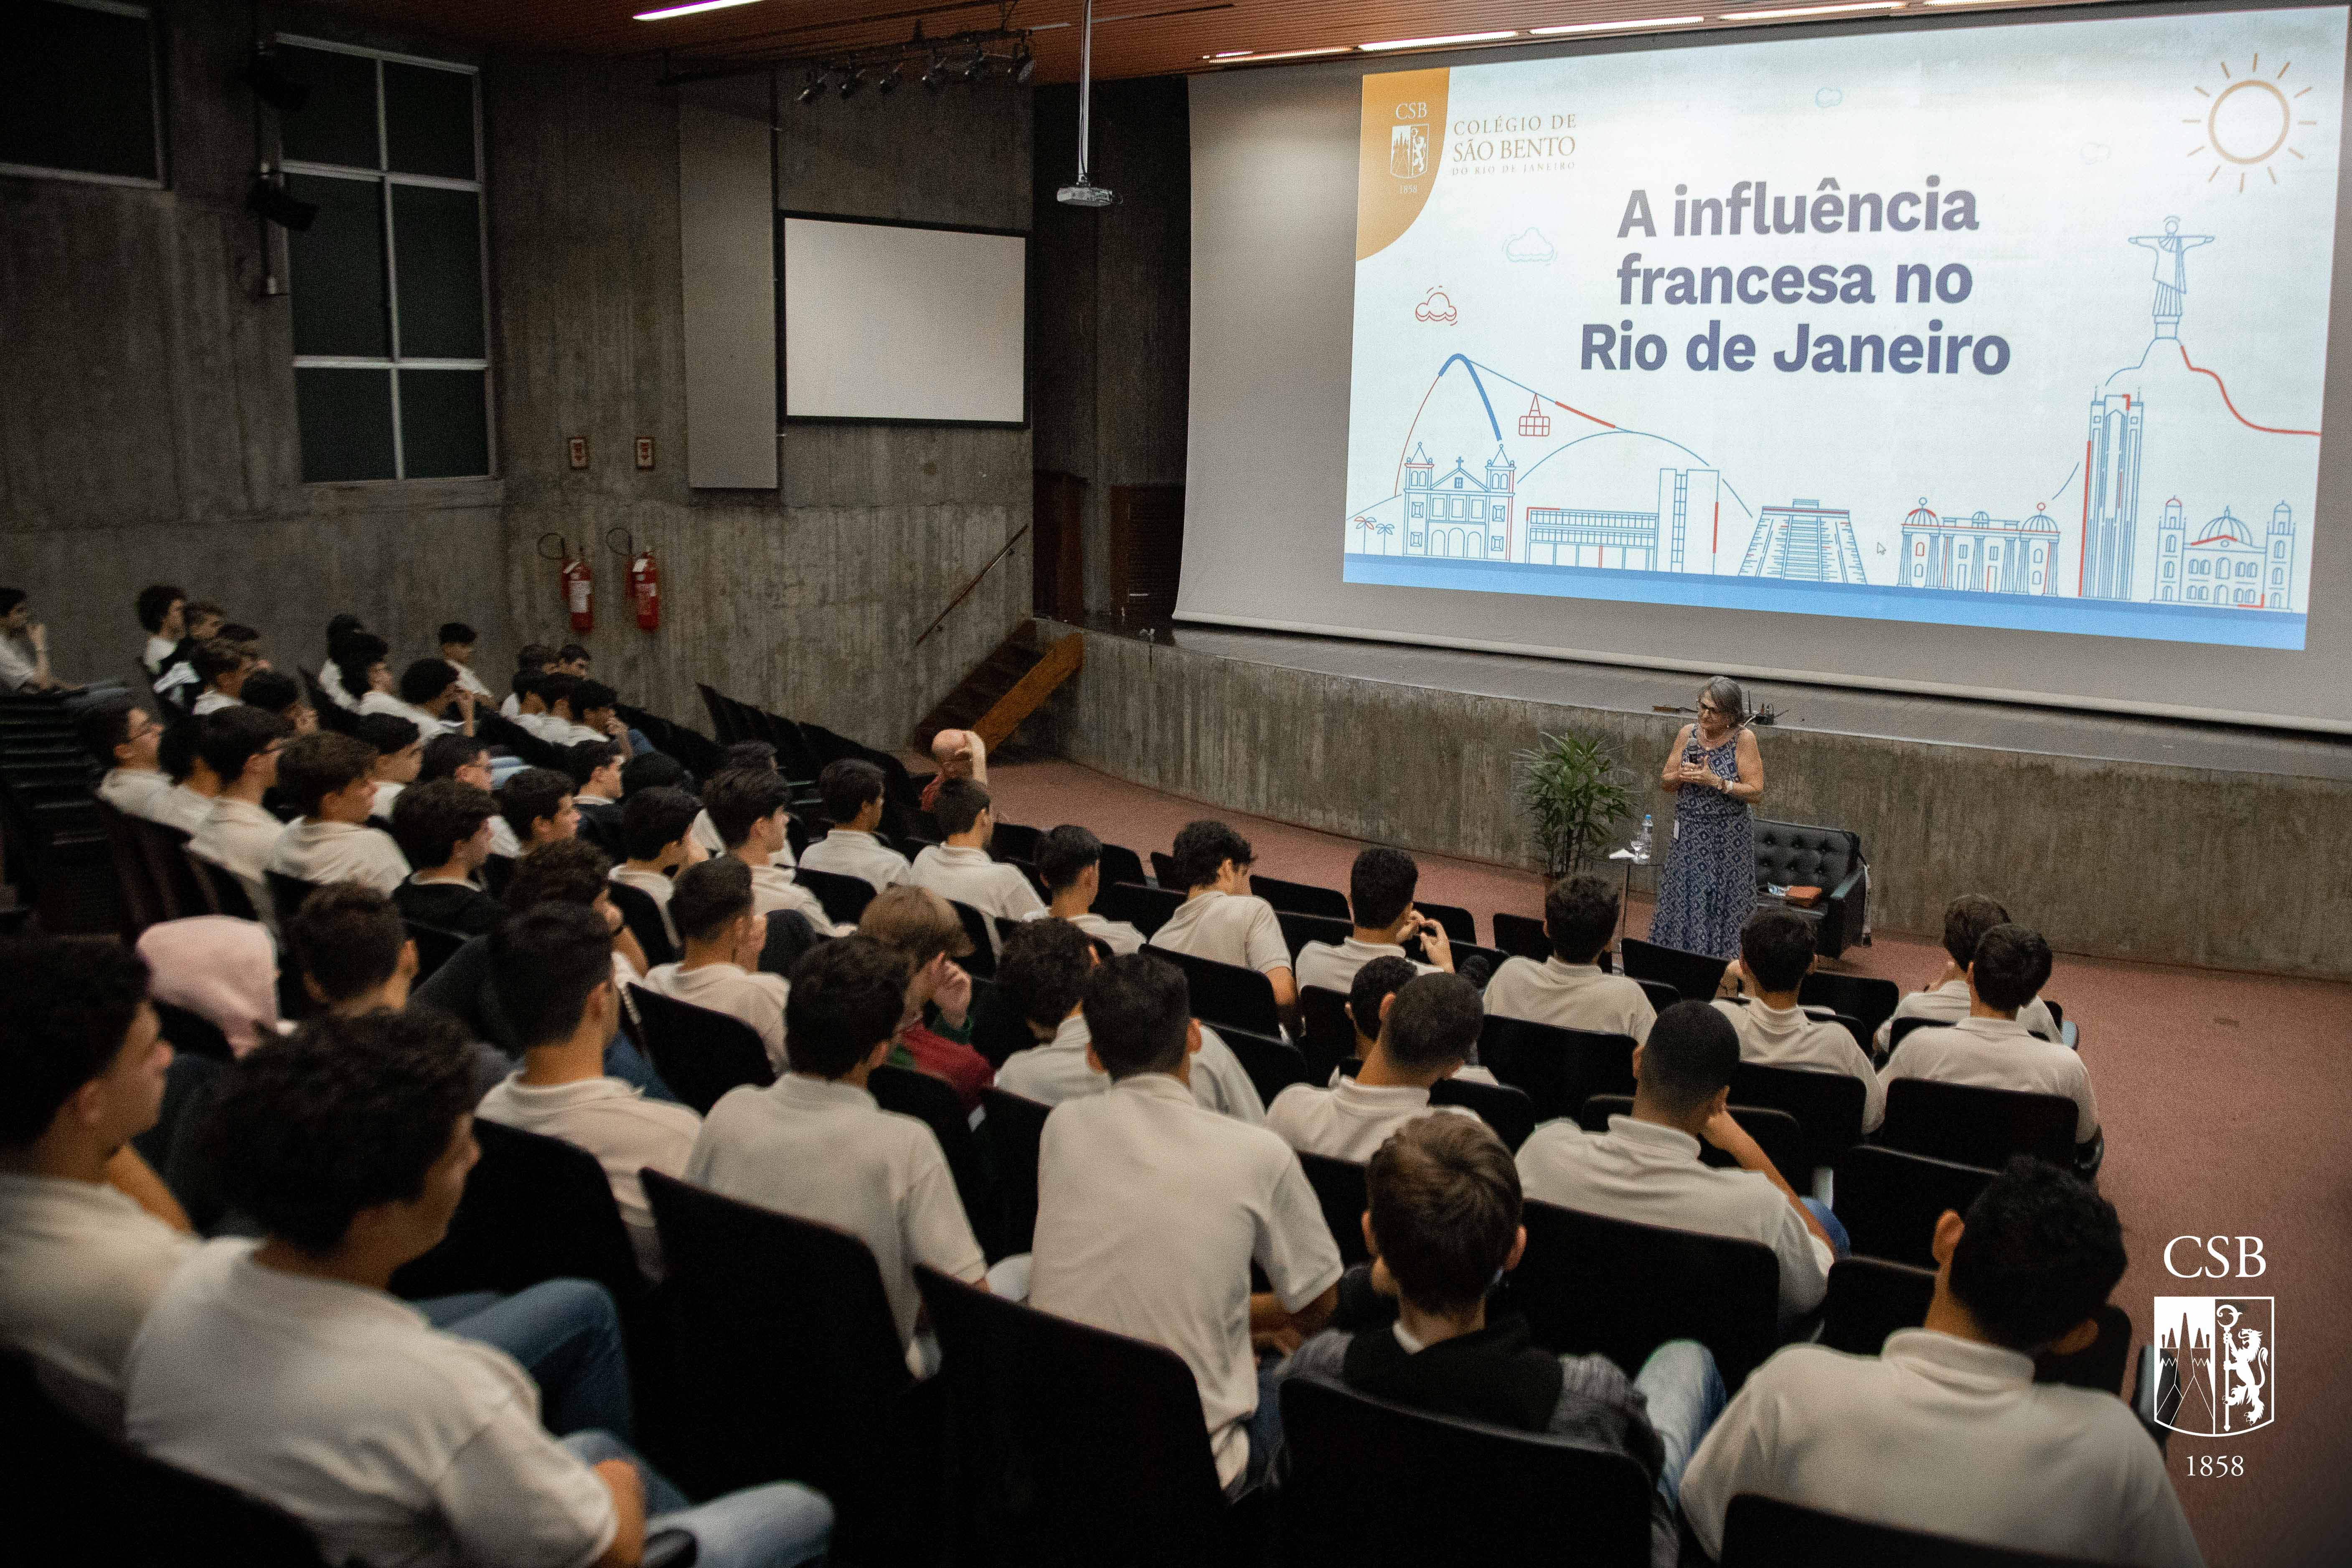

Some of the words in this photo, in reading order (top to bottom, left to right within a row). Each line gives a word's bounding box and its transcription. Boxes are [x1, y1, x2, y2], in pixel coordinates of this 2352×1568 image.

[1395, 102, 1427, 120] CSB
[1454, 115, 1541, 135] COLÉGIO
[1552, 114, 1576, 130] DE
[1453, 137, 1493, 162] SÃO
[1501, 136, 1575, 159] BENTO
[1452, 167, 1468, 175] DO
[1475, 166, 1495, 174] RIO
[1524, 162, 1575, 173] JANEIRO
[1617, 189, 1658, 238] A
[1673, 175, 1979, 237] influência
[1616, 252, 1876, 305] francesa
[1895, 262, 1973, 304] no
[1580, 319, 1668, 371] Rio
[1686, 319, 1756, 371] de
[1773, 318, 2011, 375] Janeiro
